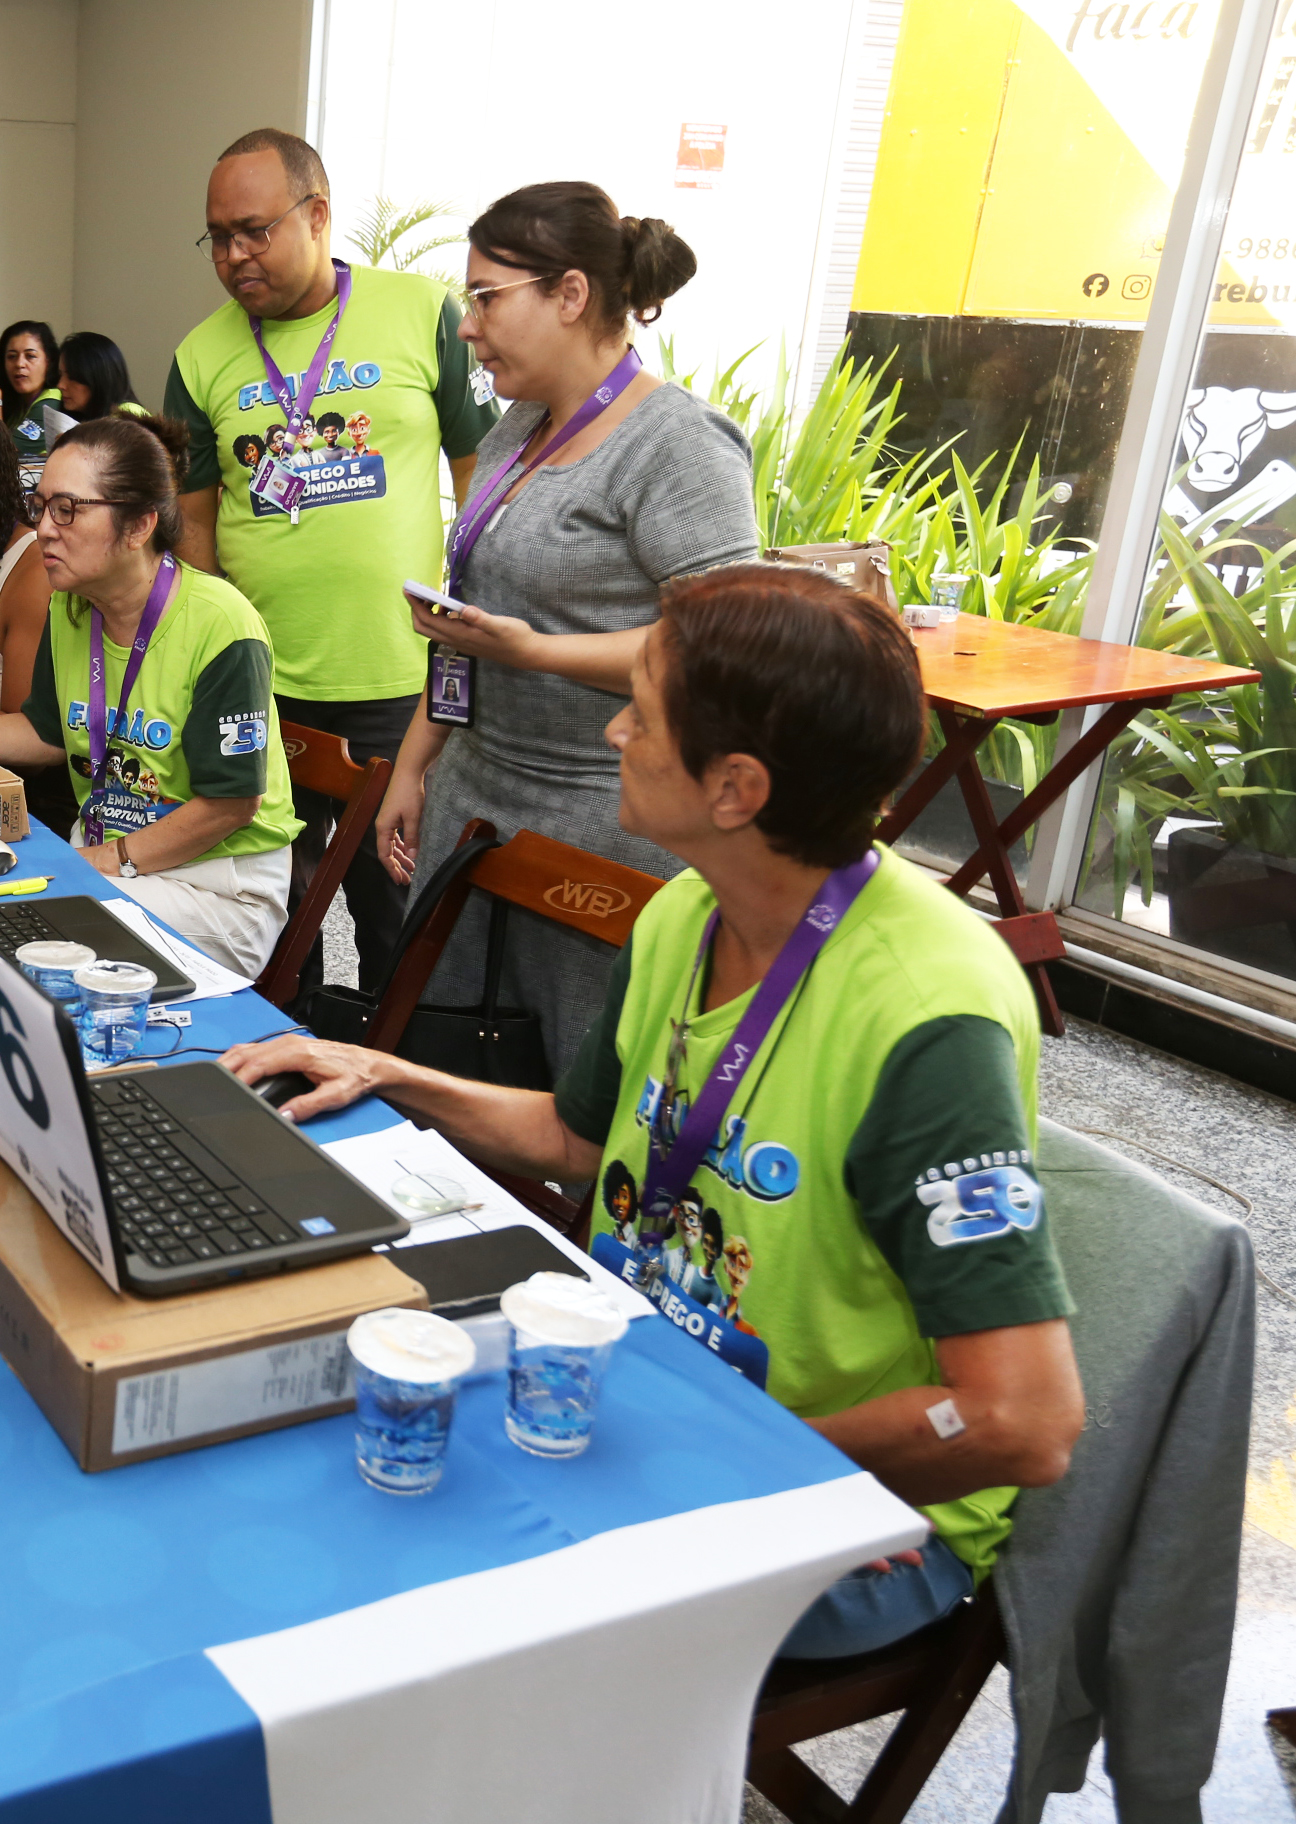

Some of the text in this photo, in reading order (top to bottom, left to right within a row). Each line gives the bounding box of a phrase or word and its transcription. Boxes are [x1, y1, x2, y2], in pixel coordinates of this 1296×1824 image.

[1212, 275, 1296, 303] rebu
[350, 462, 361, 476] E
[561, 879, 613, 919] WB
[915, 1165, 1043, 1247] 250
[707, 1324, 724, 1351] E
